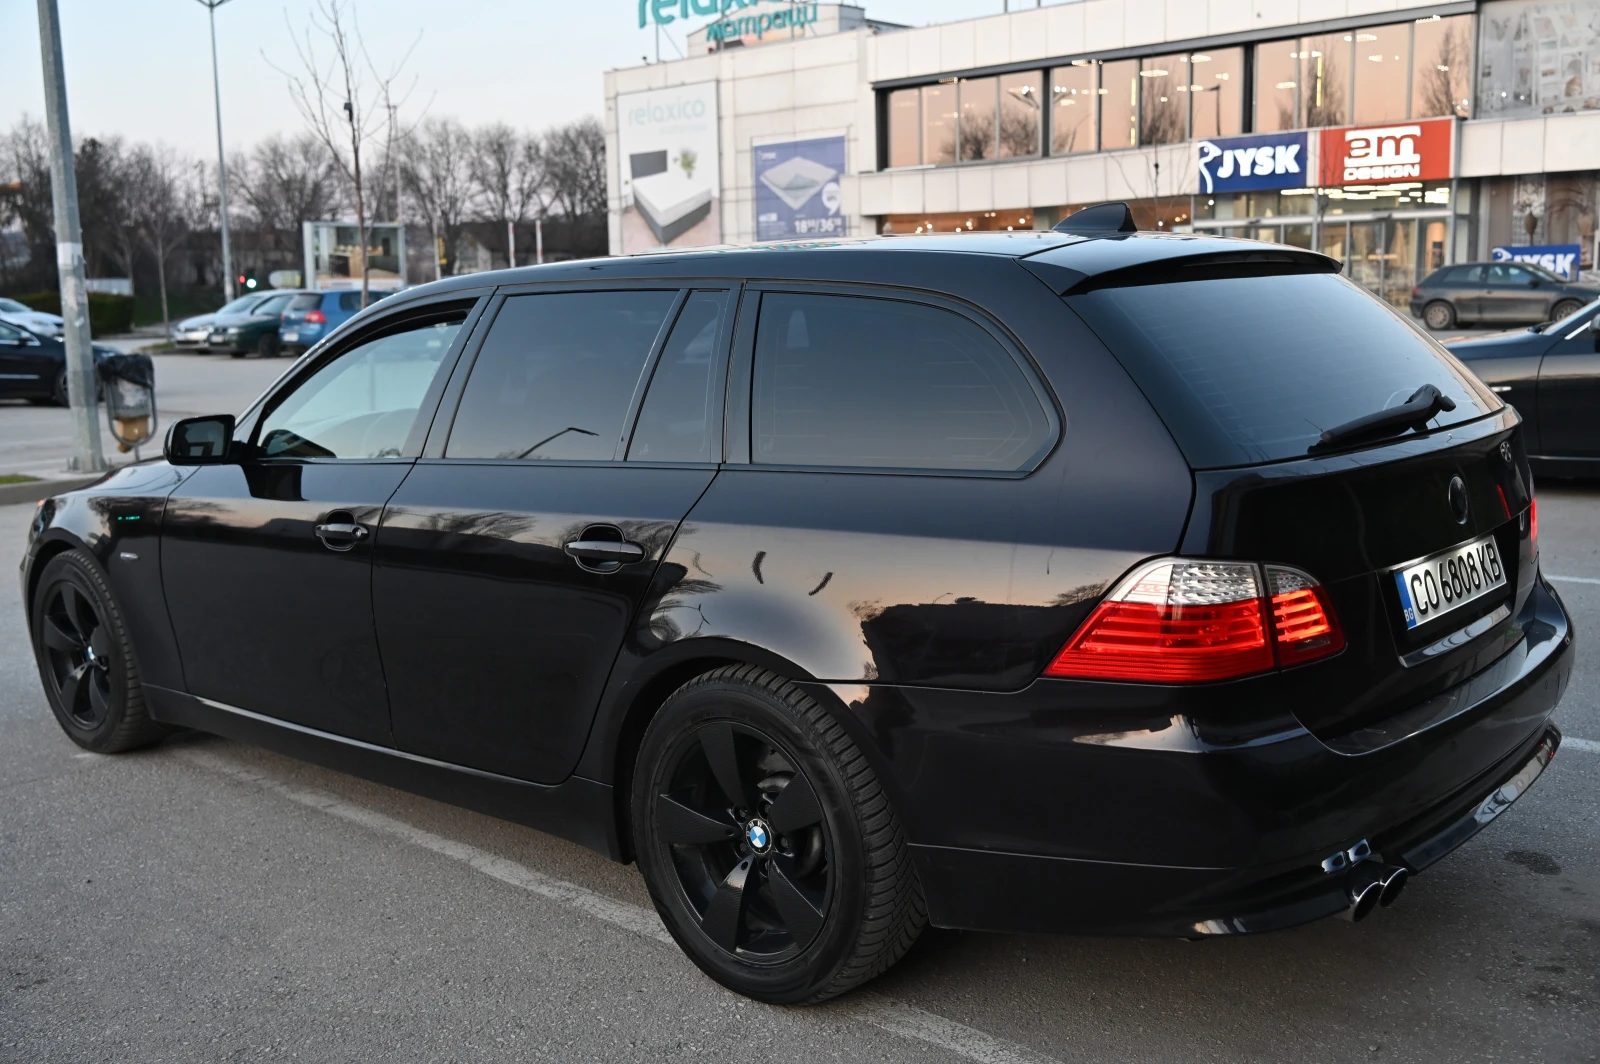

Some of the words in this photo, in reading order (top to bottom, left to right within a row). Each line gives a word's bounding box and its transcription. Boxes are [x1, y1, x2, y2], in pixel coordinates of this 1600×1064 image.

[627, 96, 706, 127] relaxico
[1217, 144, 1301, 178] JYSK
[1343, 164, 1420, 181] DESIGN
[1404, 607, 1415, 622] BG
